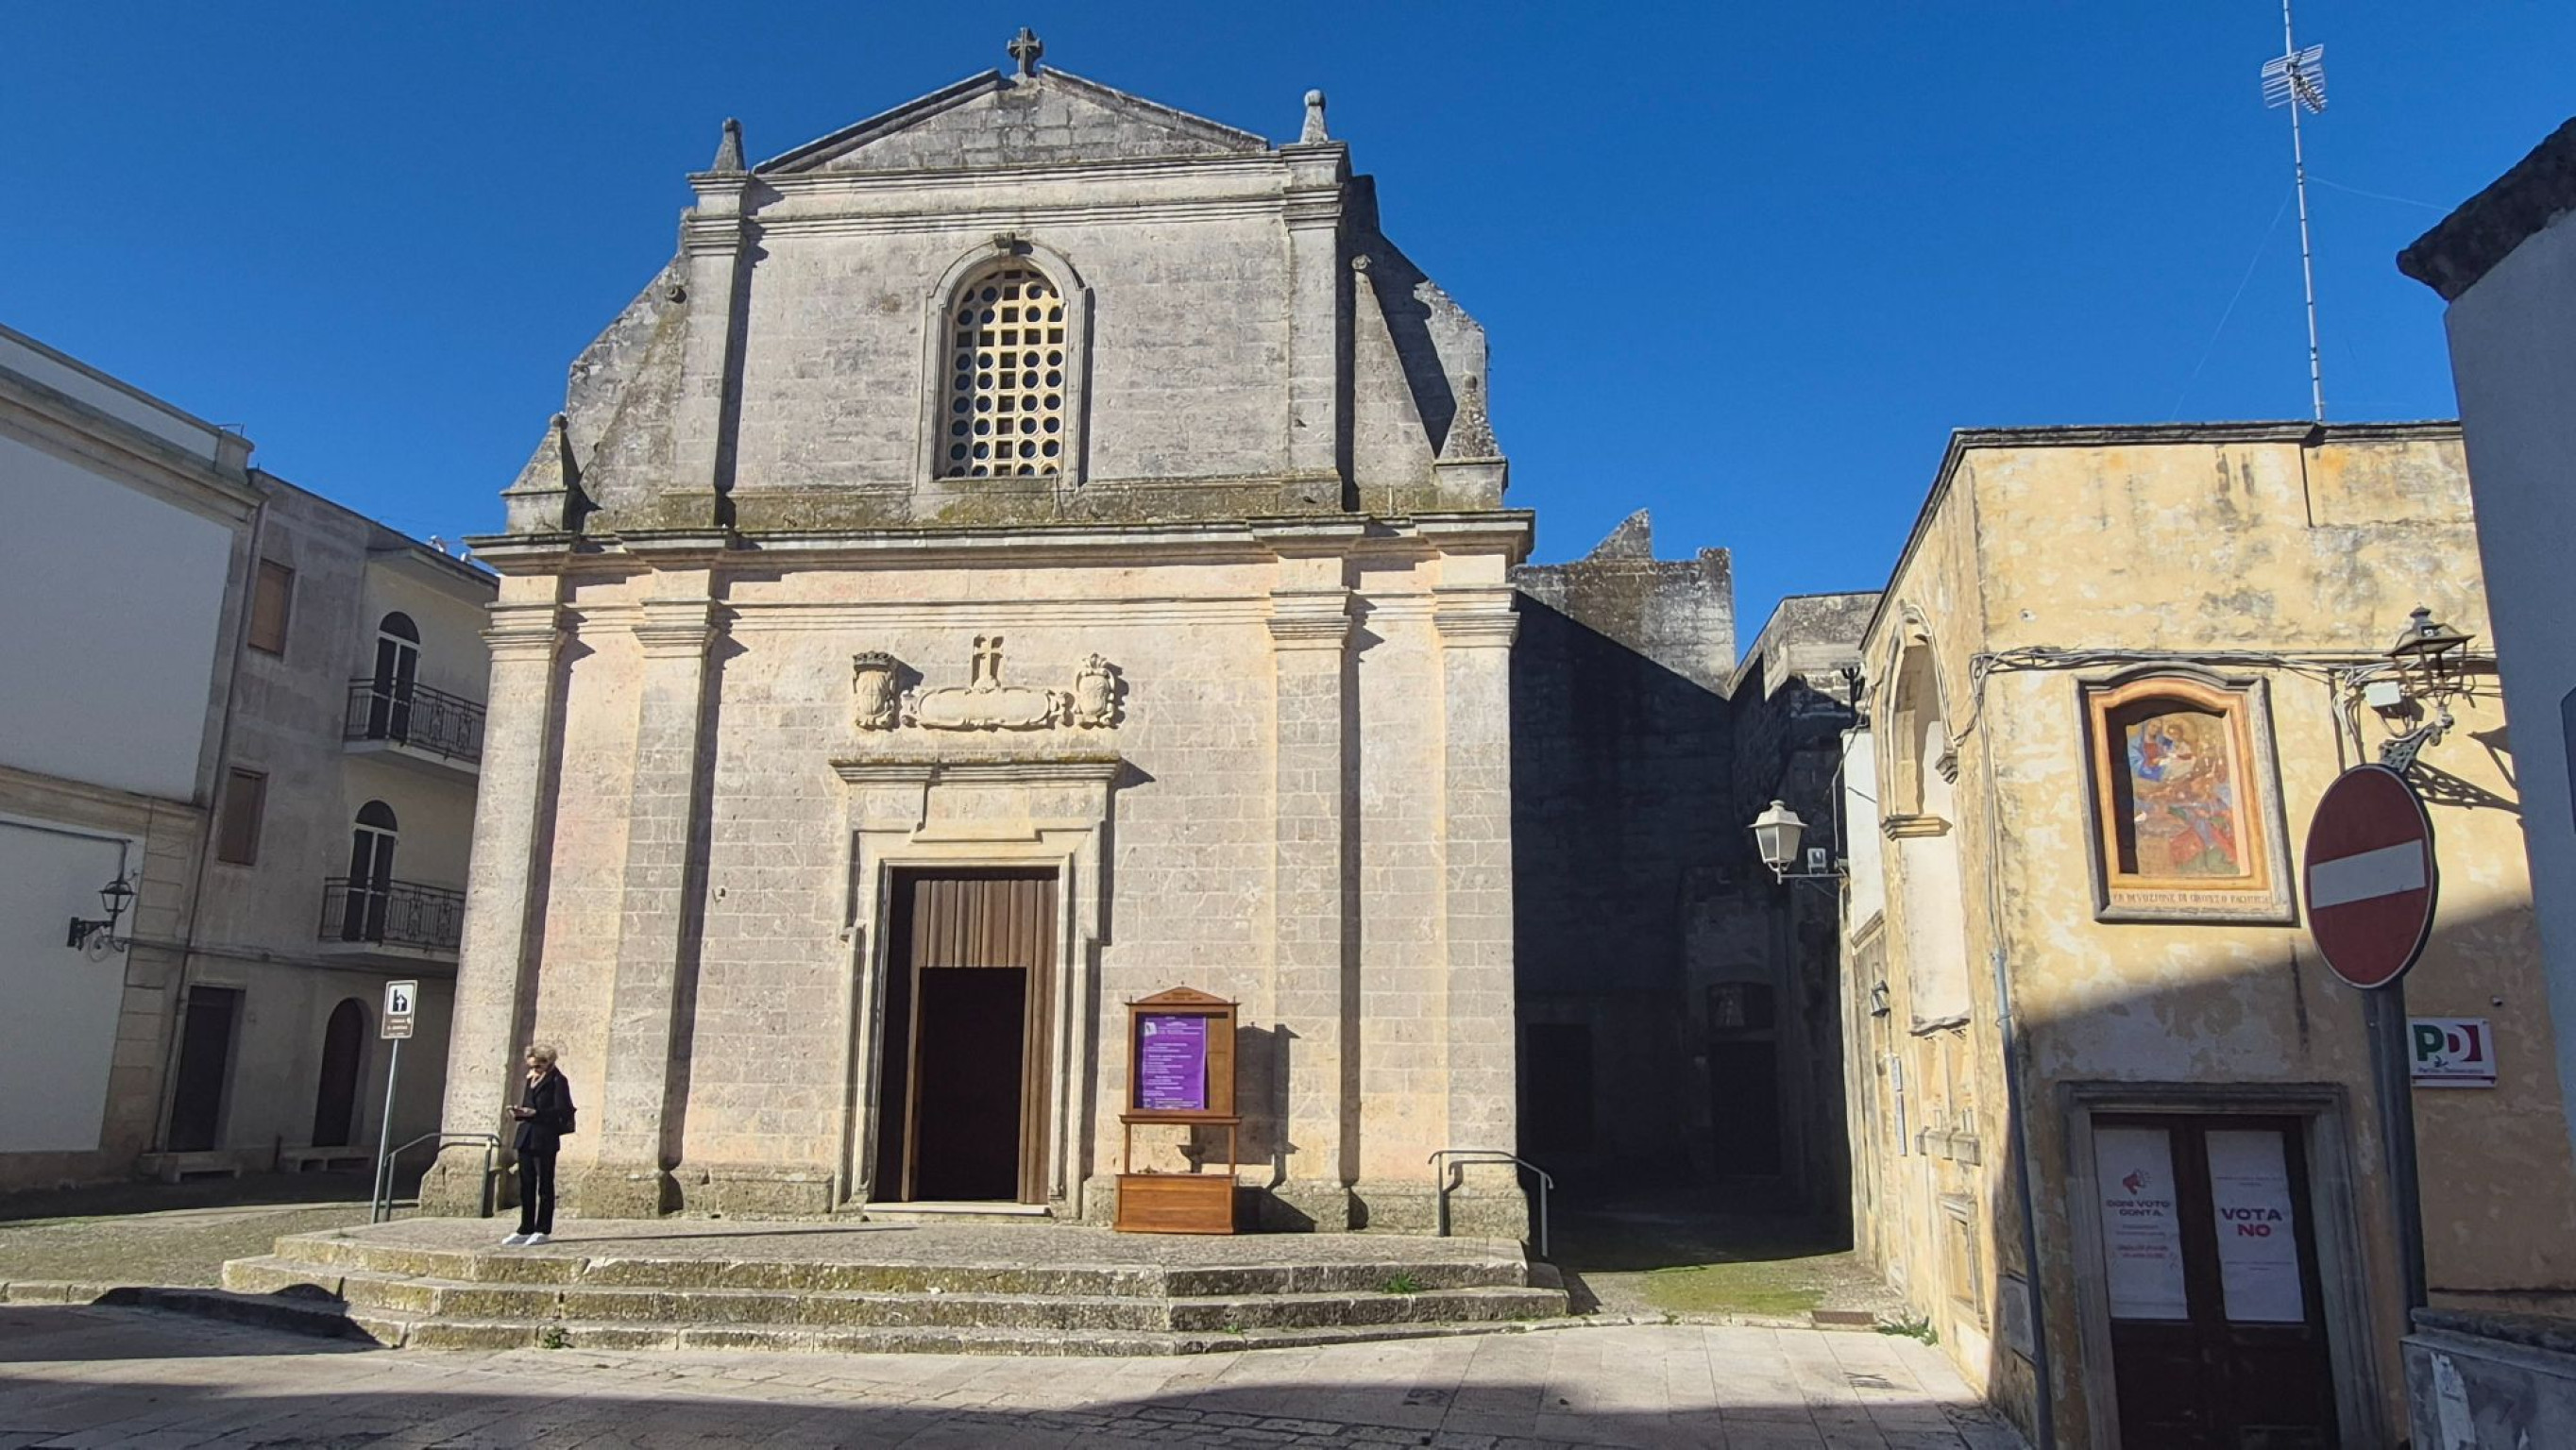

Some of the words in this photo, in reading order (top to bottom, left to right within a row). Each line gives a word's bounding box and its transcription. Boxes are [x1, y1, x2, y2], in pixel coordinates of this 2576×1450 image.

[2413, 1024, 2483, 1062] PD
[2221, 1207, 2282, 1221] VOTA
[2237, 1223, 2272, 1238] NO
